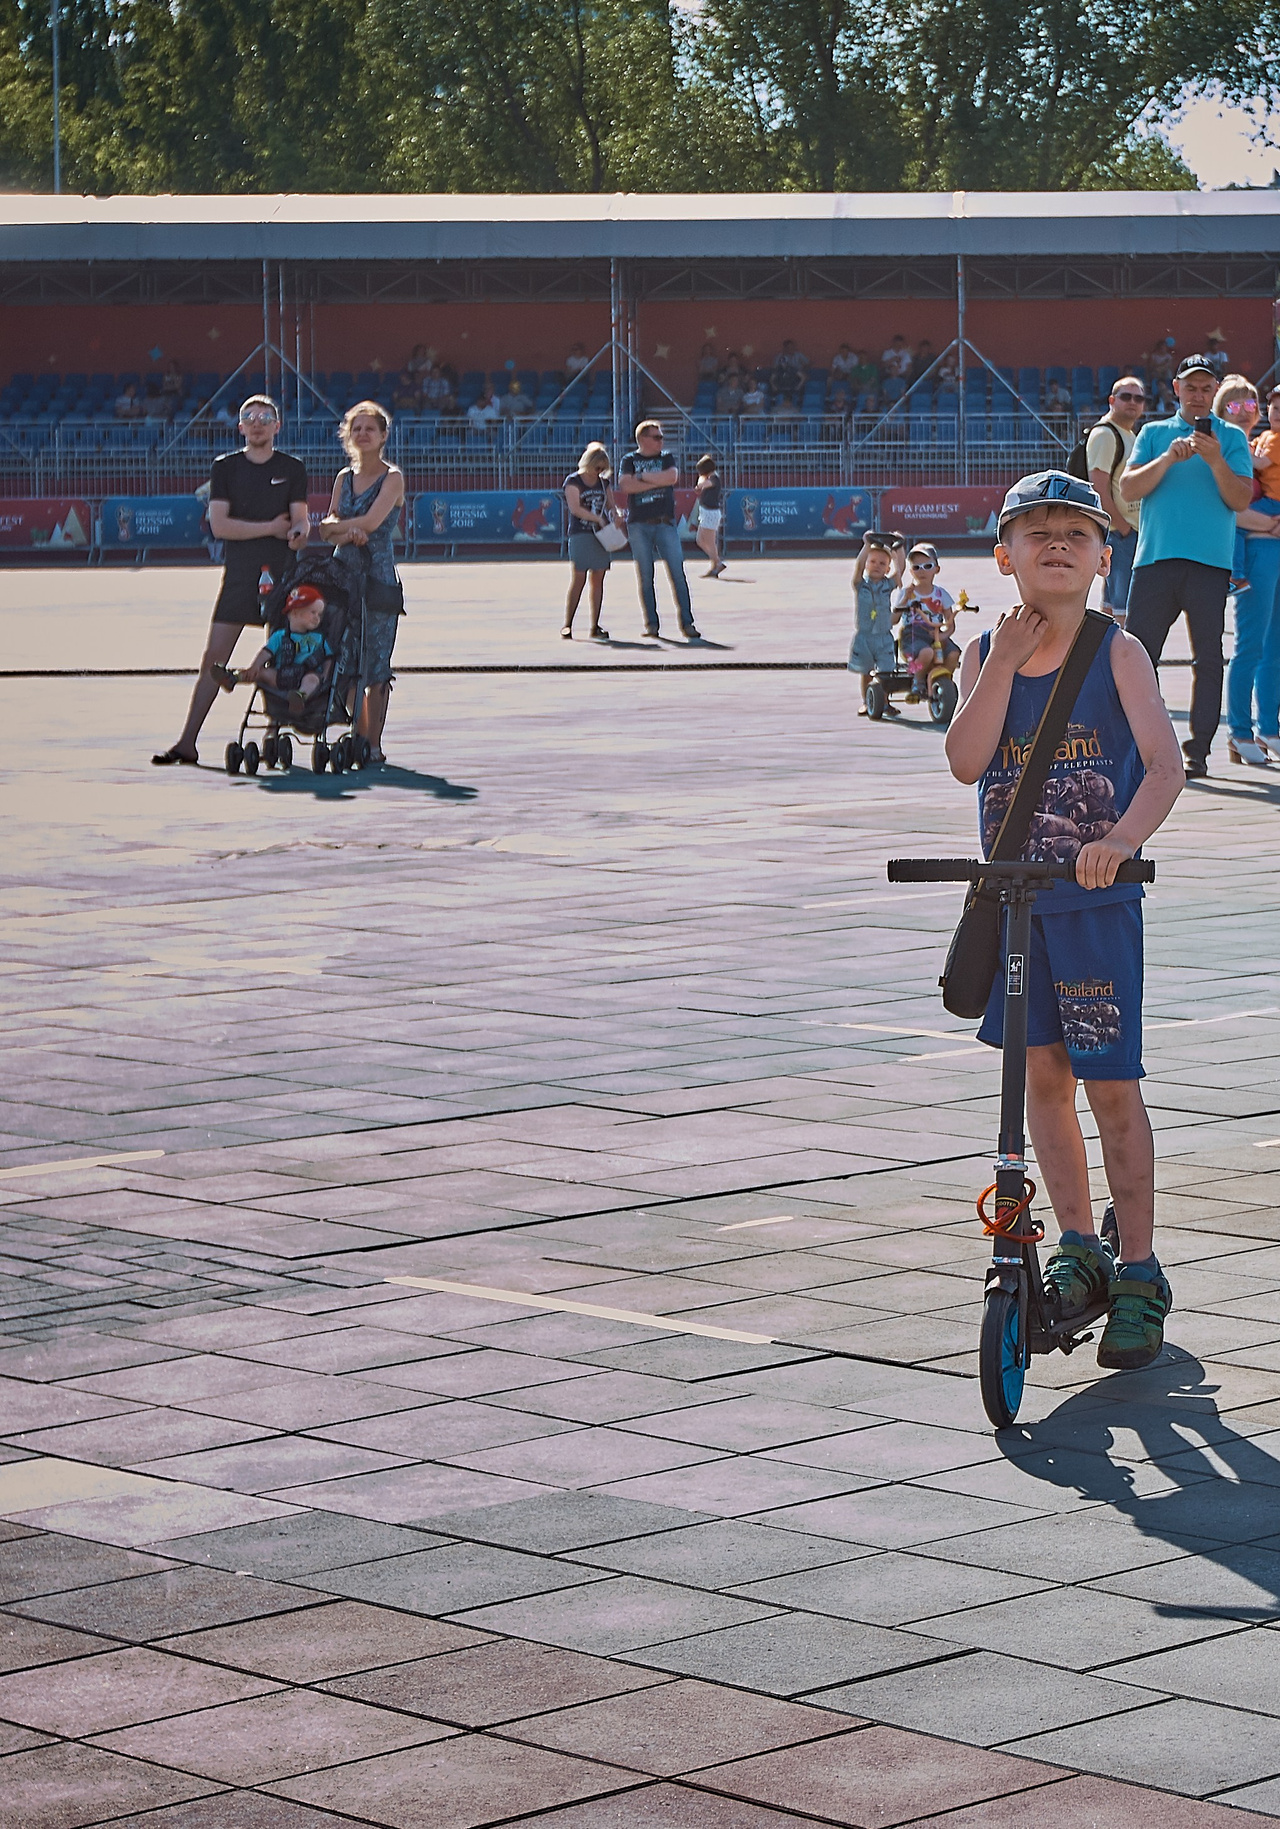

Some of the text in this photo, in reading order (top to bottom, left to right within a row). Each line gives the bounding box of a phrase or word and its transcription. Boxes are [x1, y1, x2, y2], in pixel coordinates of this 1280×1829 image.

[760, 506, 798, 515] RUSSIA
[892, 504, 959, 513] FIFA FAN FEST
[450, 510, 487, 519] RUSSIA
[135, 516, 174, 526] RUSSIA
[451, 519, 475, 528] 2018
[760, 515, 784, 525] 2018
[136, 526, 160, 535] 2018
[1054, 980, 1114, 997] Thailand
